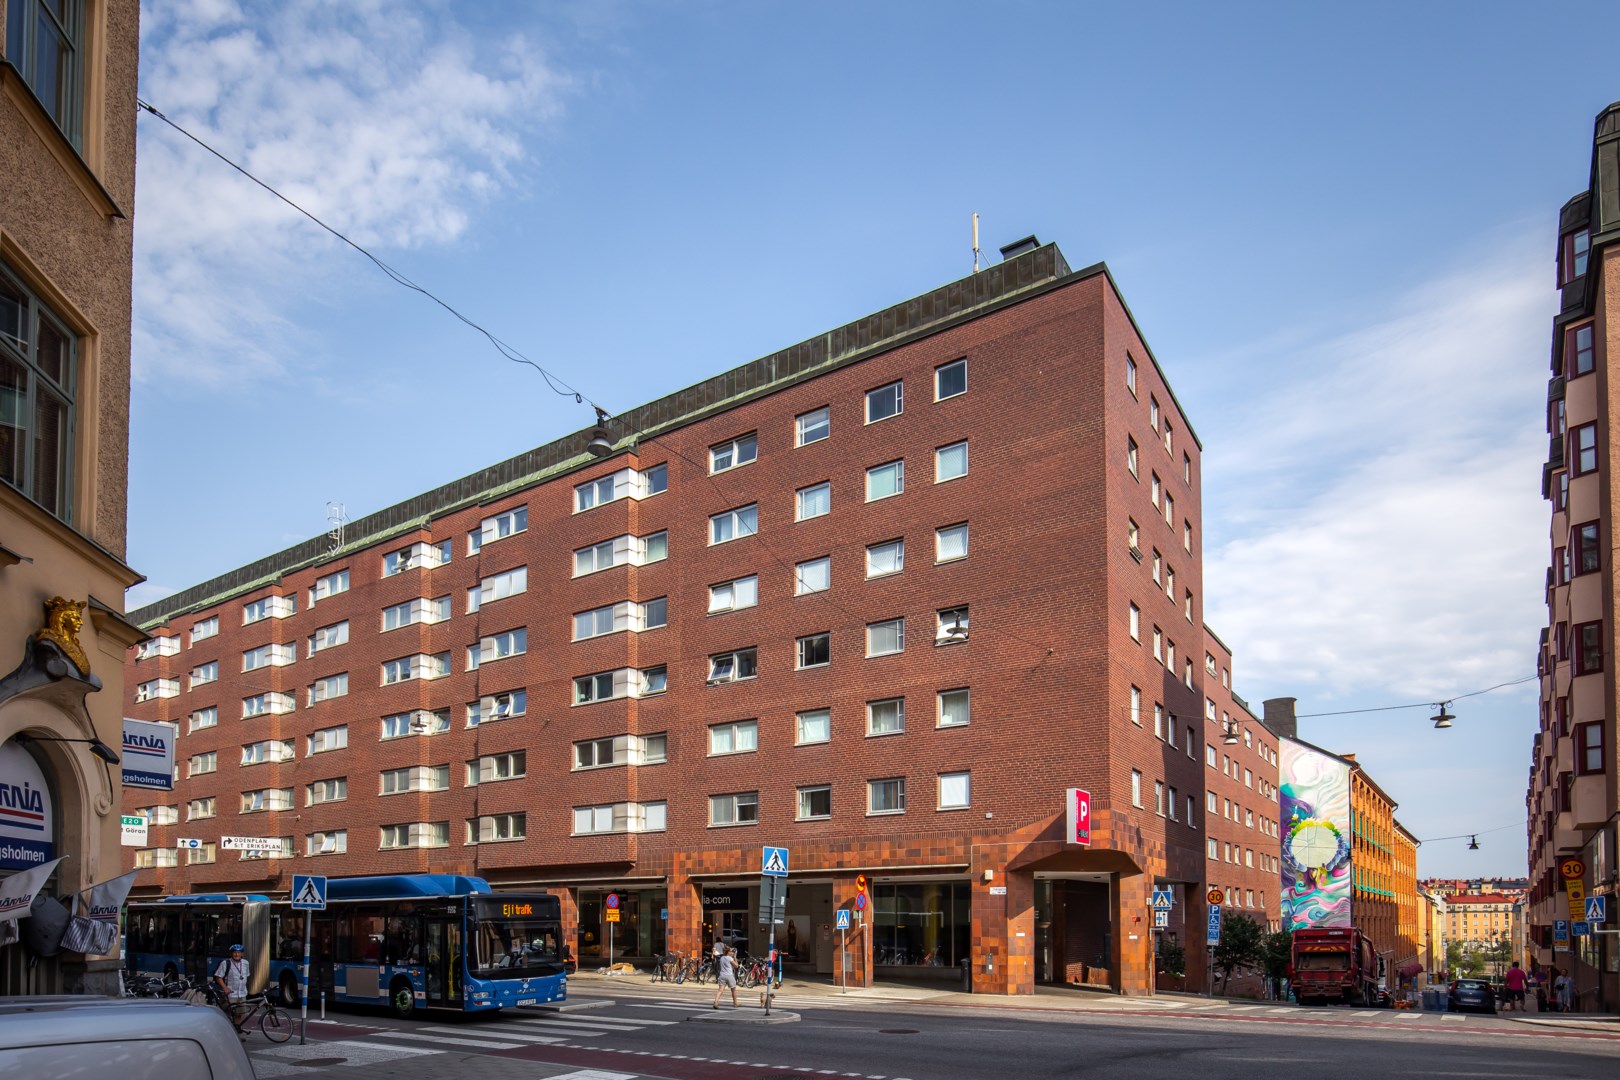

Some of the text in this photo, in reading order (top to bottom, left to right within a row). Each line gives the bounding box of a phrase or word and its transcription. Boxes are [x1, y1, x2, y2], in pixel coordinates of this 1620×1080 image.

[1081, 801, 1088, 822] P
[1564, 863, 1582, 875] 30
[1210, 893, 1221, 901] 30
[503, 904, 511, 917] Ej
[1212, 905, 1219, 914] P
[1557, 921, 1565, 930] P
